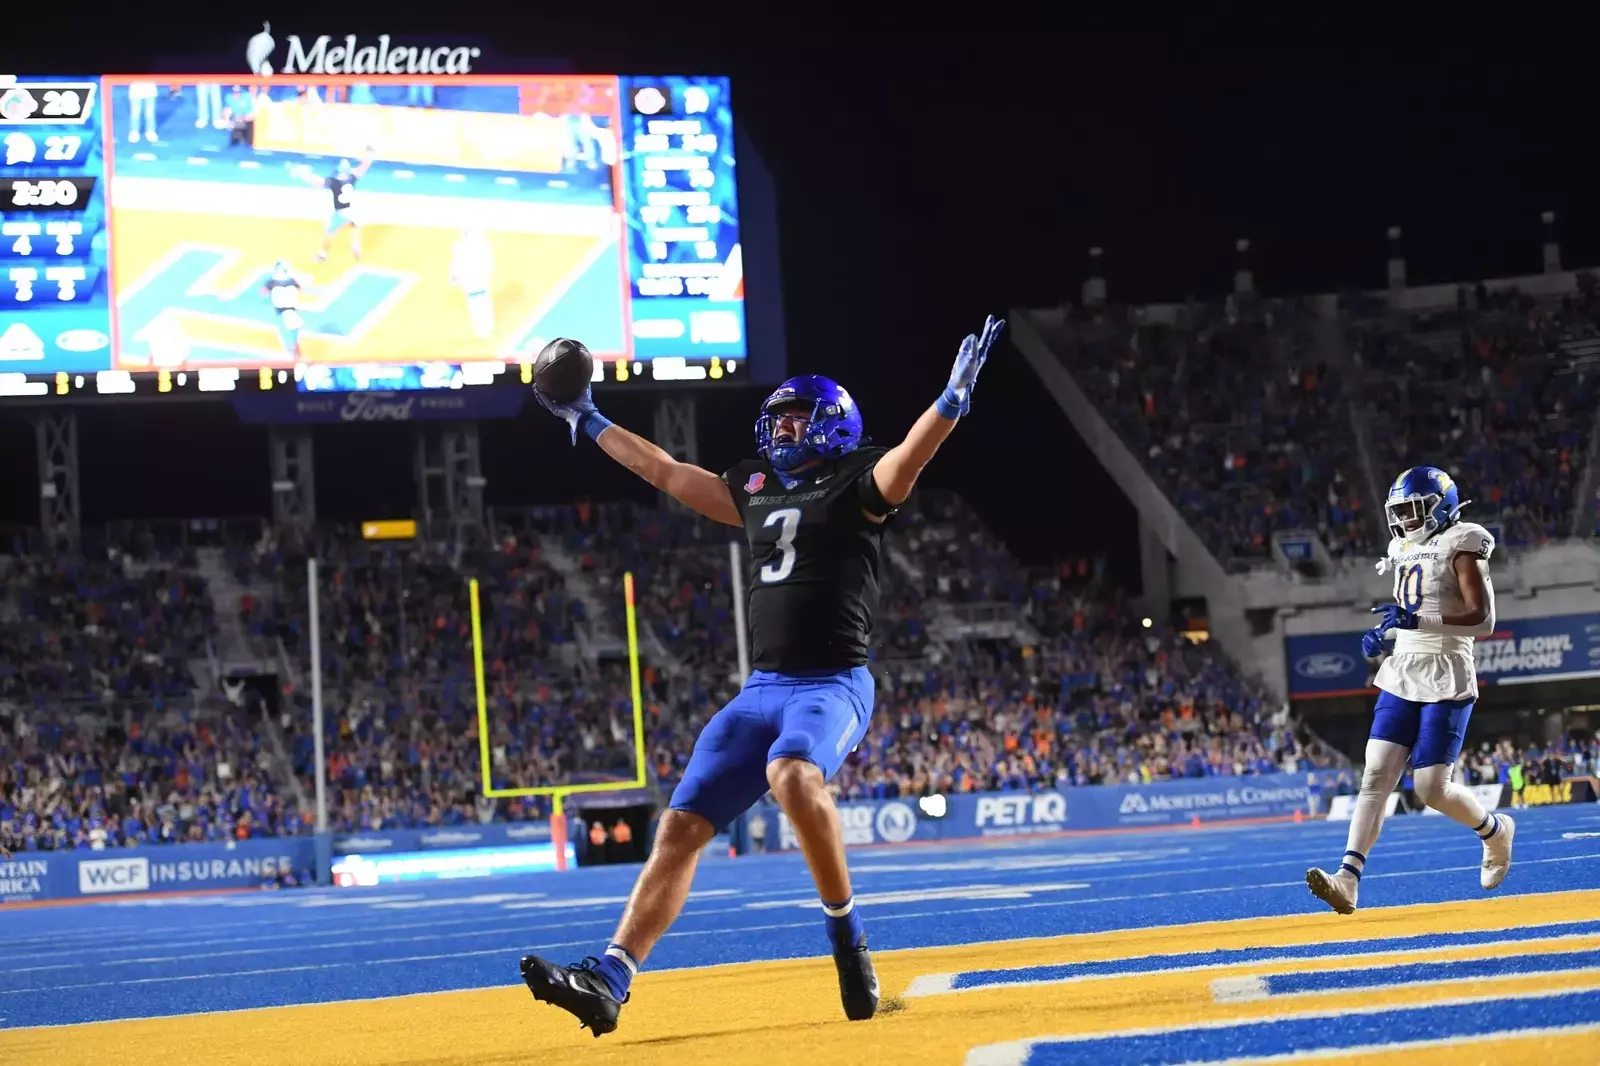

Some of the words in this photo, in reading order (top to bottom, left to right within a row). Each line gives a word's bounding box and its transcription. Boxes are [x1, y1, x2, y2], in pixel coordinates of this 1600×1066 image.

[281, 34, 473, 75] Melaleuca
[42, 90, 81, 115] 28
[44, 135, 82, 160] 27
[340, 391, 415, 421] Ford
[760, 507, 802, 584] 3
[1397, 563, 1423, 613] 10
[1520, 634, 1574, 654] BOWL
[974, 795, 1032, 828] PET
[1032, 792, 1067, 824] IQ
[1226, 787, 1240, 805] &
[86, 864, 143, 886] WCF
[151, 856, 292, 882] INSURANCE
